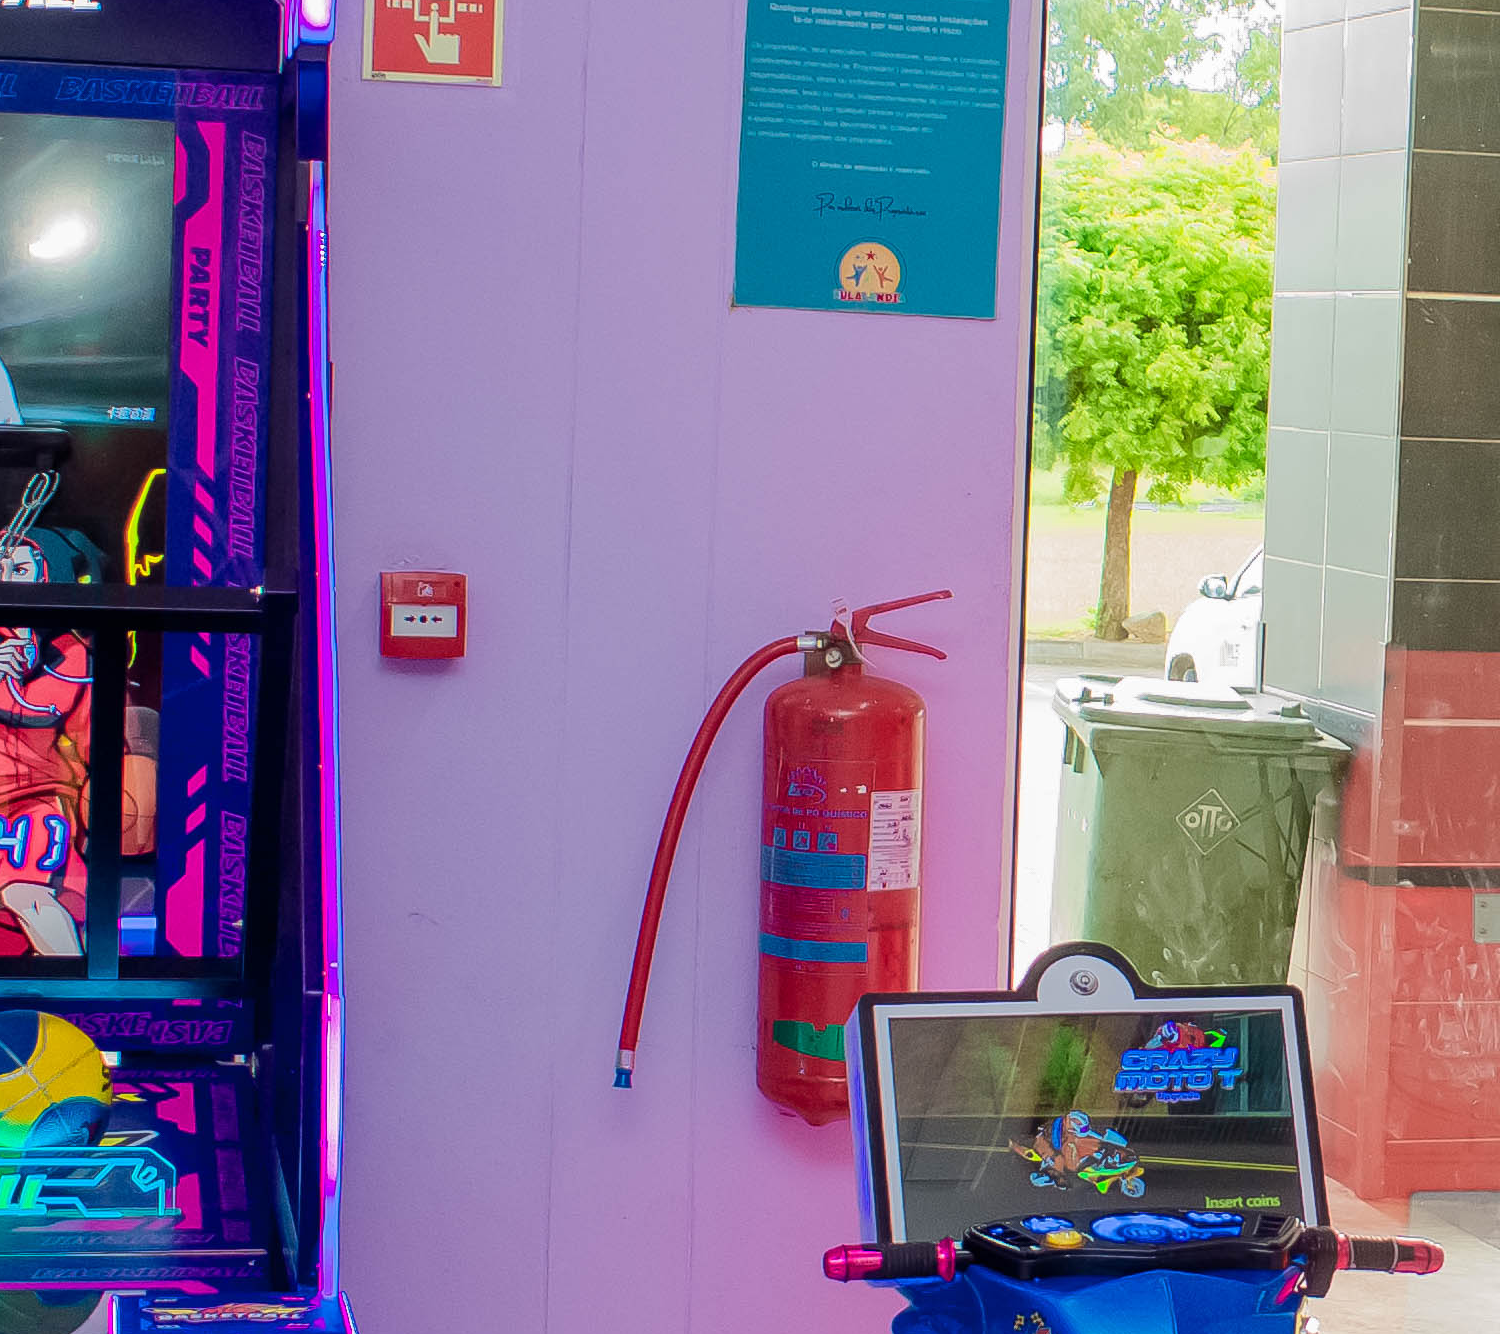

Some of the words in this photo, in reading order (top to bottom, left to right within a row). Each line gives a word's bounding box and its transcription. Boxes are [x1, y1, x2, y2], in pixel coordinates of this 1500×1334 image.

[55, 74, 264, 111] BASKETBALL
[233, 130, 268, 332] BASKETBALL
[183, 247, 212, 349] PARTY
[228, 357, 262, 560] BASKETBALL
[1121, 1047, 1239, 1071] CRAZY
[1114, 1069, 1213, 1092] MOTO
[1205, 1196, 1244, 1209] Insert
[1246, 1195, 1281, 1208] coins
